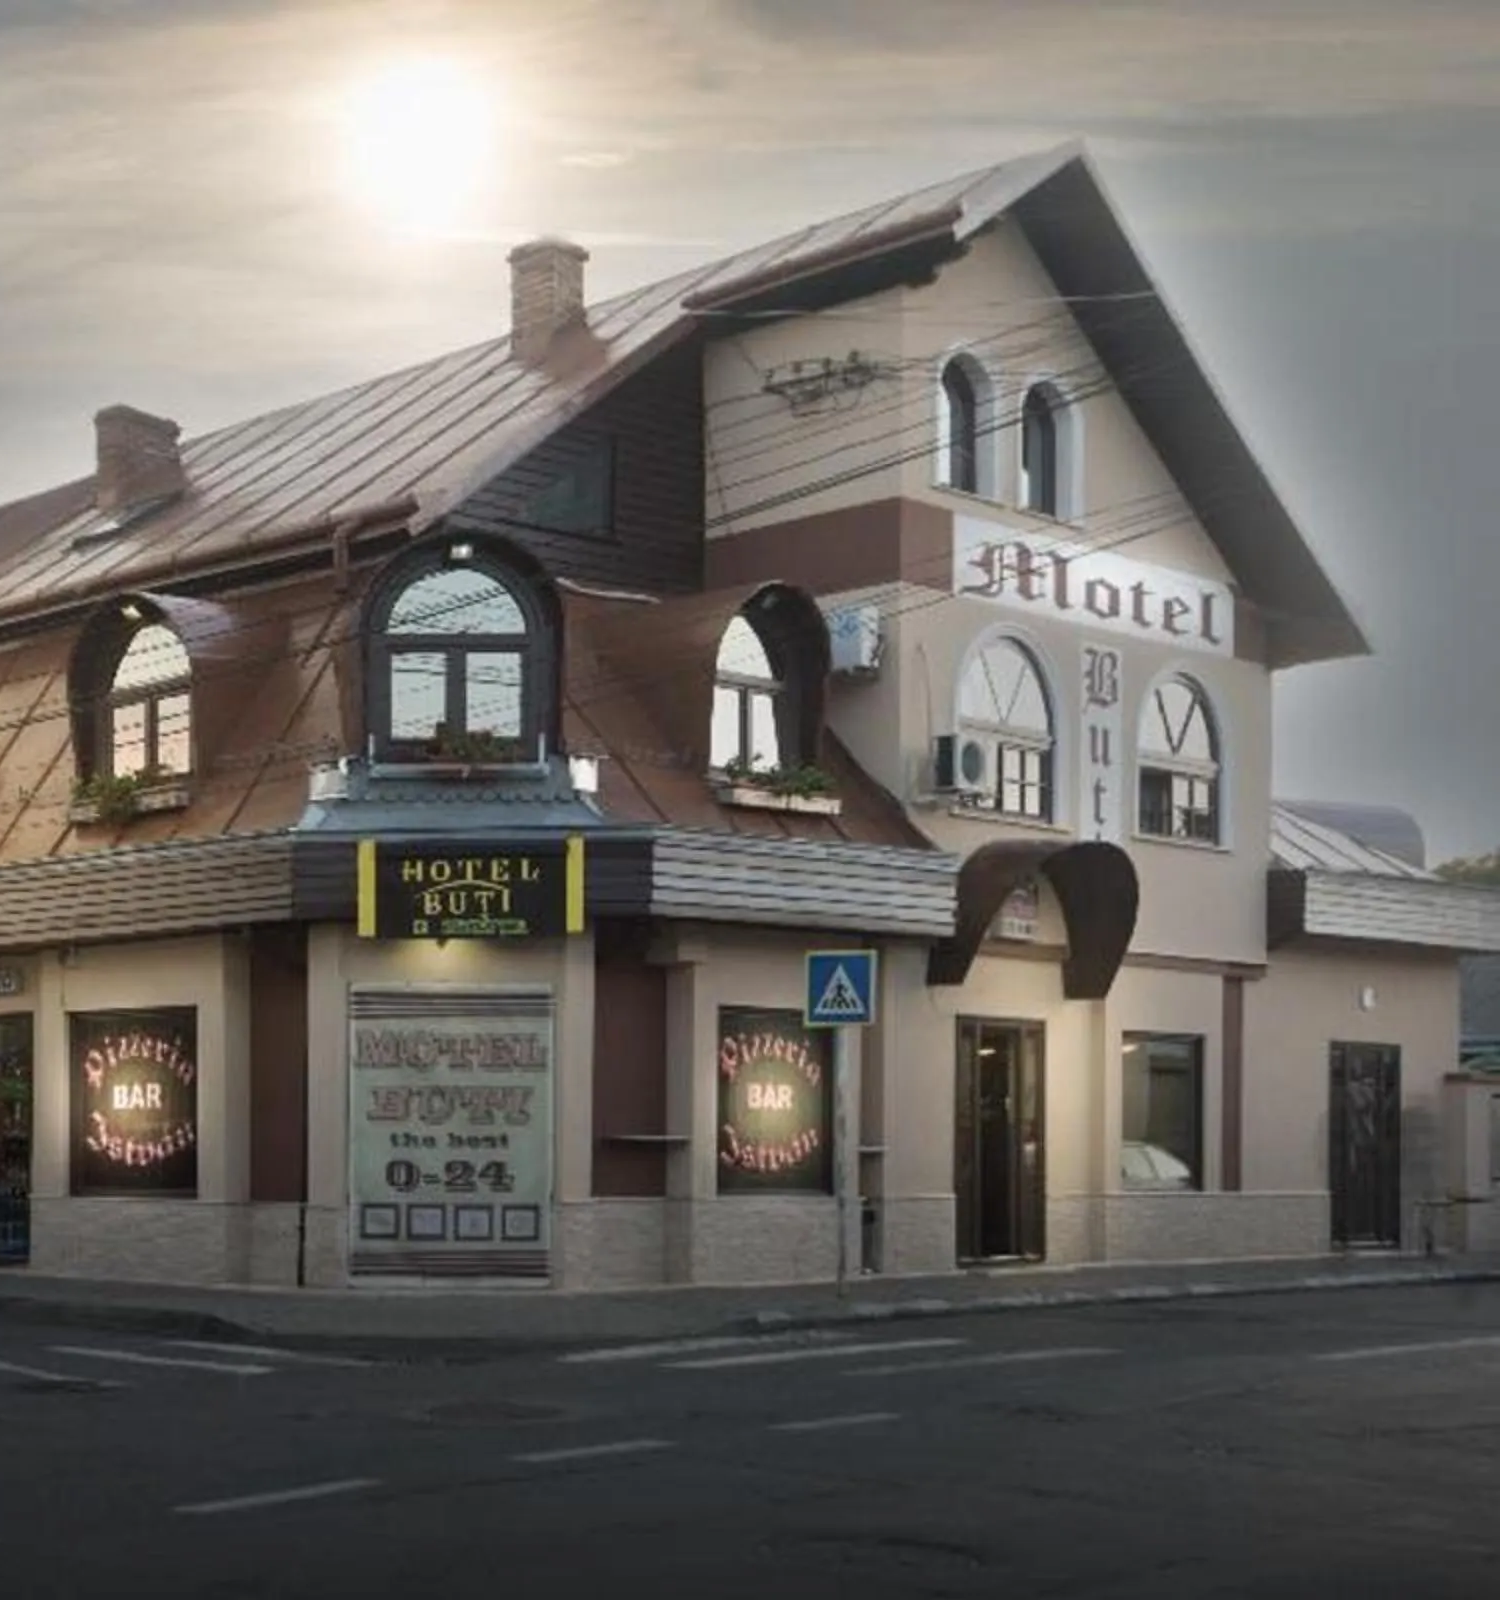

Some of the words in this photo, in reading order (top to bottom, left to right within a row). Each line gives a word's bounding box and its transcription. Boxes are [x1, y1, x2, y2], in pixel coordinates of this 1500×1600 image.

[959, 541, 1221, 646] Motel
[1082, 647, 1119, 840] But
[402, 858, 540, 883] HOTEL
[422, 887, 510, 915] BUTI
[85, 1033, 194, 1089] Pizzeria
[353, 1028, 548, 1073] MOTEL
[720, 1033, 821, 1087] Pizzeria
[112, 1082, 163, 1110] BAR
[747, 1082, 793, 1110] BAR
[389, 1132, 437, 1149] the
[446, 1132, 509, 1149] best
[385, 1160, 515, 1193] 0-24
